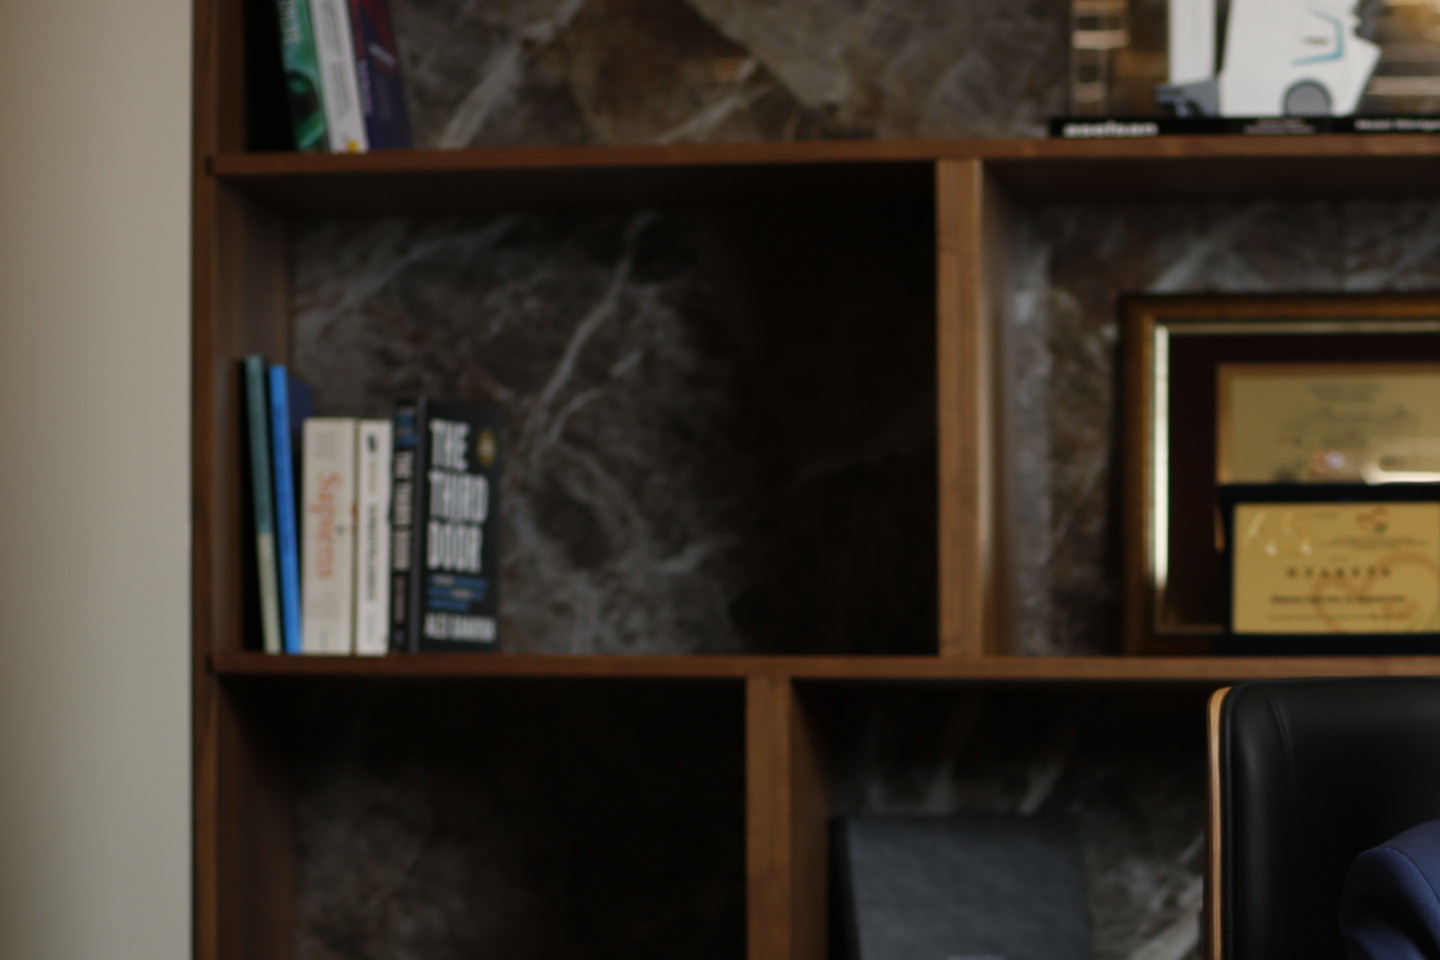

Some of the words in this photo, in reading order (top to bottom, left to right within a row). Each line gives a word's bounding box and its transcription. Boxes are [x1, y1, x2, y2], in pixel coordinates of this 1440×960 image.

[431, 419, 469, 471] THE
[428, 471, 489, 523] THIRD
[309, 471, 343, 580] Sapiens
[427, 521, 482, 572] DOOR
